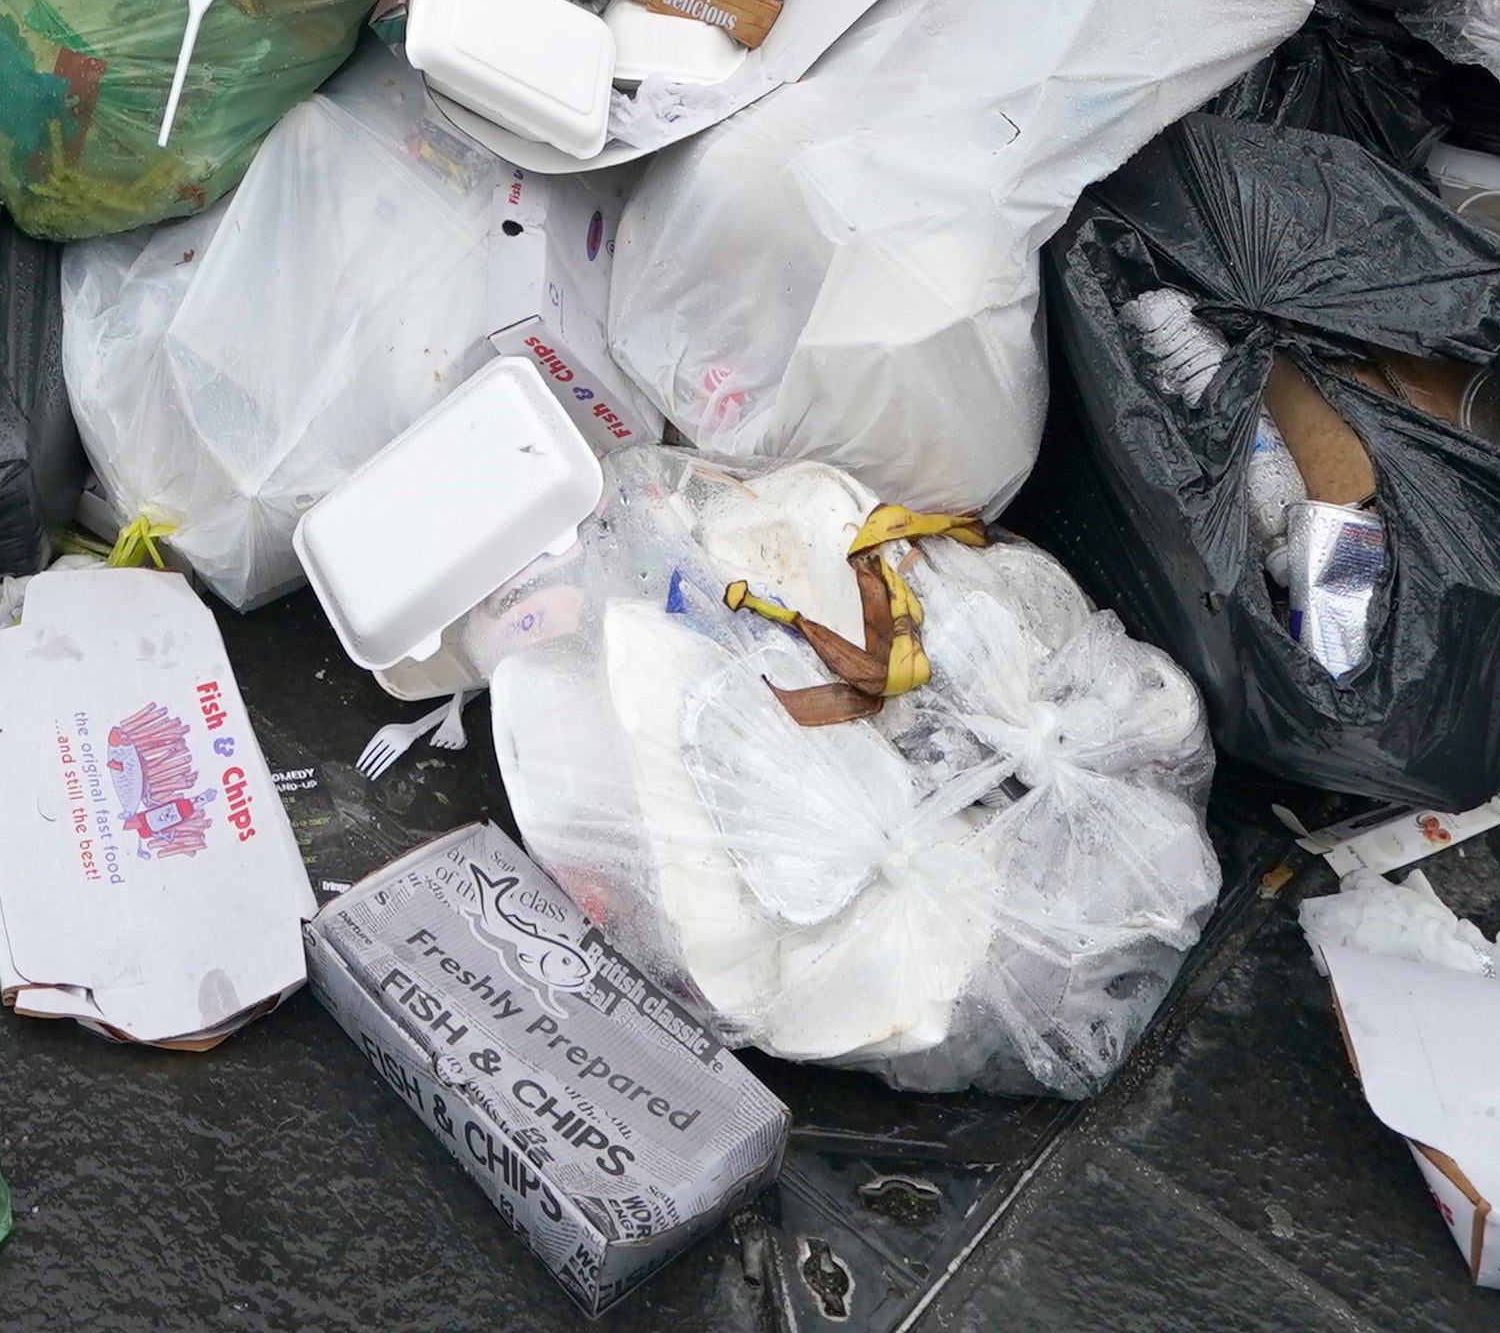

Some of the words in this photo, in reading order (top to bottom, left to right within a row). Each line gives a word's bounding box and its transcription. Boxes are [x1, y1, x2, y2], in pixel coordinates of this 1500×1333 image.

[523, 335, 574, 383] Chips
[572, 386, 594, 401] &
[592, 402, 632, 439] Fish
[74, 711, 90, 738] the
[196, 681, 228, 731] Fish
[213, 736, 236, 757] &
[64, 770, 85, 802] still
[82, 742, 106, 804] original
[272, 767, 315, 783] OMEDY
[72, 807, 88, 833] the
[96, 809, 113, 841] fast
[222, 765, 256, 842] Chips
[78, 839, 102, 882] best!
[104, 845, 126, 885] food
[587, 939, 649, 1004] British
[641, 995, 711, 1057] classic
[405, 928, 524, 1022] Freshly
[526, 1012, 702, 1133] Prepared
[380, 967, 469, 1047] FISH
[470, 1046, 503, 1078] &
[511, 1077, 637, 1177] CHIPS
[360, 1033, 425, 1113] FISH
[431, 1092, 454, 1140] &
[463, 1119, 564, 1223] CHIPS
